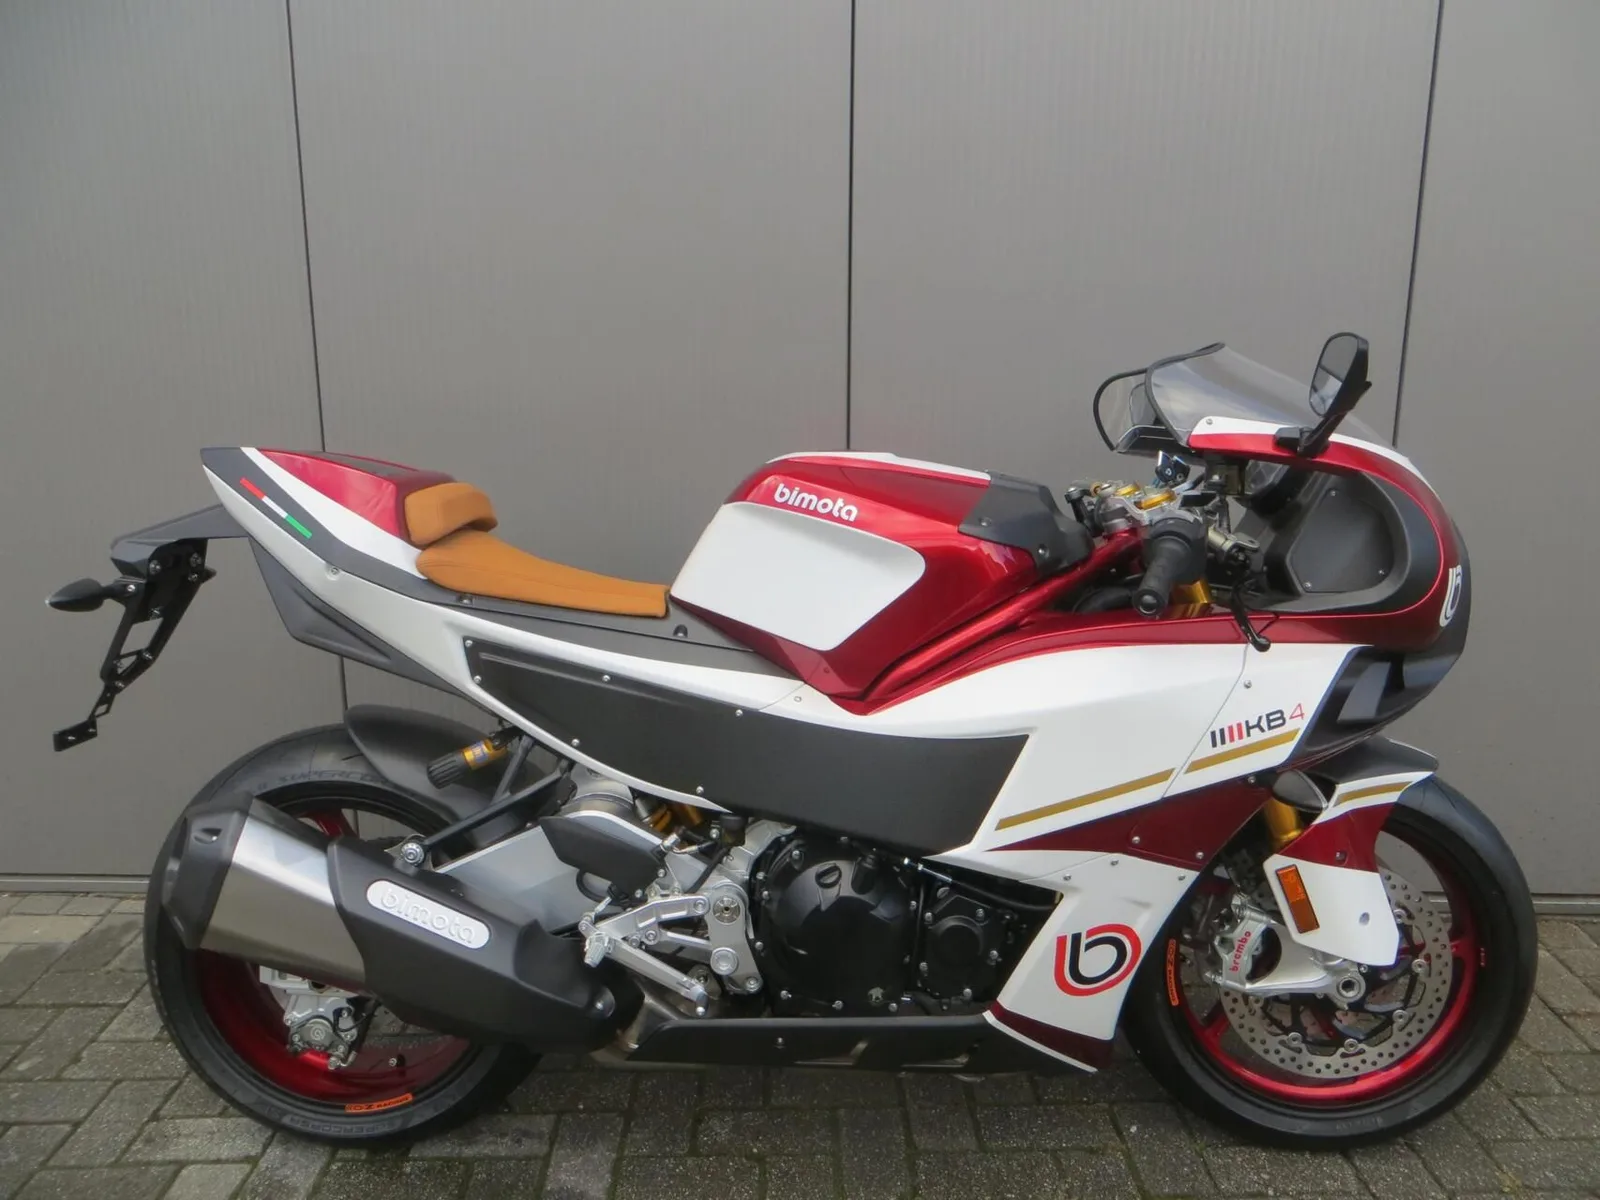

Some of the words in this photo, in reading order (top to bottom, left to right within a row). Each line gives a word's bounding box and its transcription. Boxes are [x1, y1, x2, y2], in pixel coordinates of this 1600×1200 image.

[774, 483, 858, 522] bimota
[381, 887, 476, 943] bimota
[1229, 930, 1252, 973] brembo
